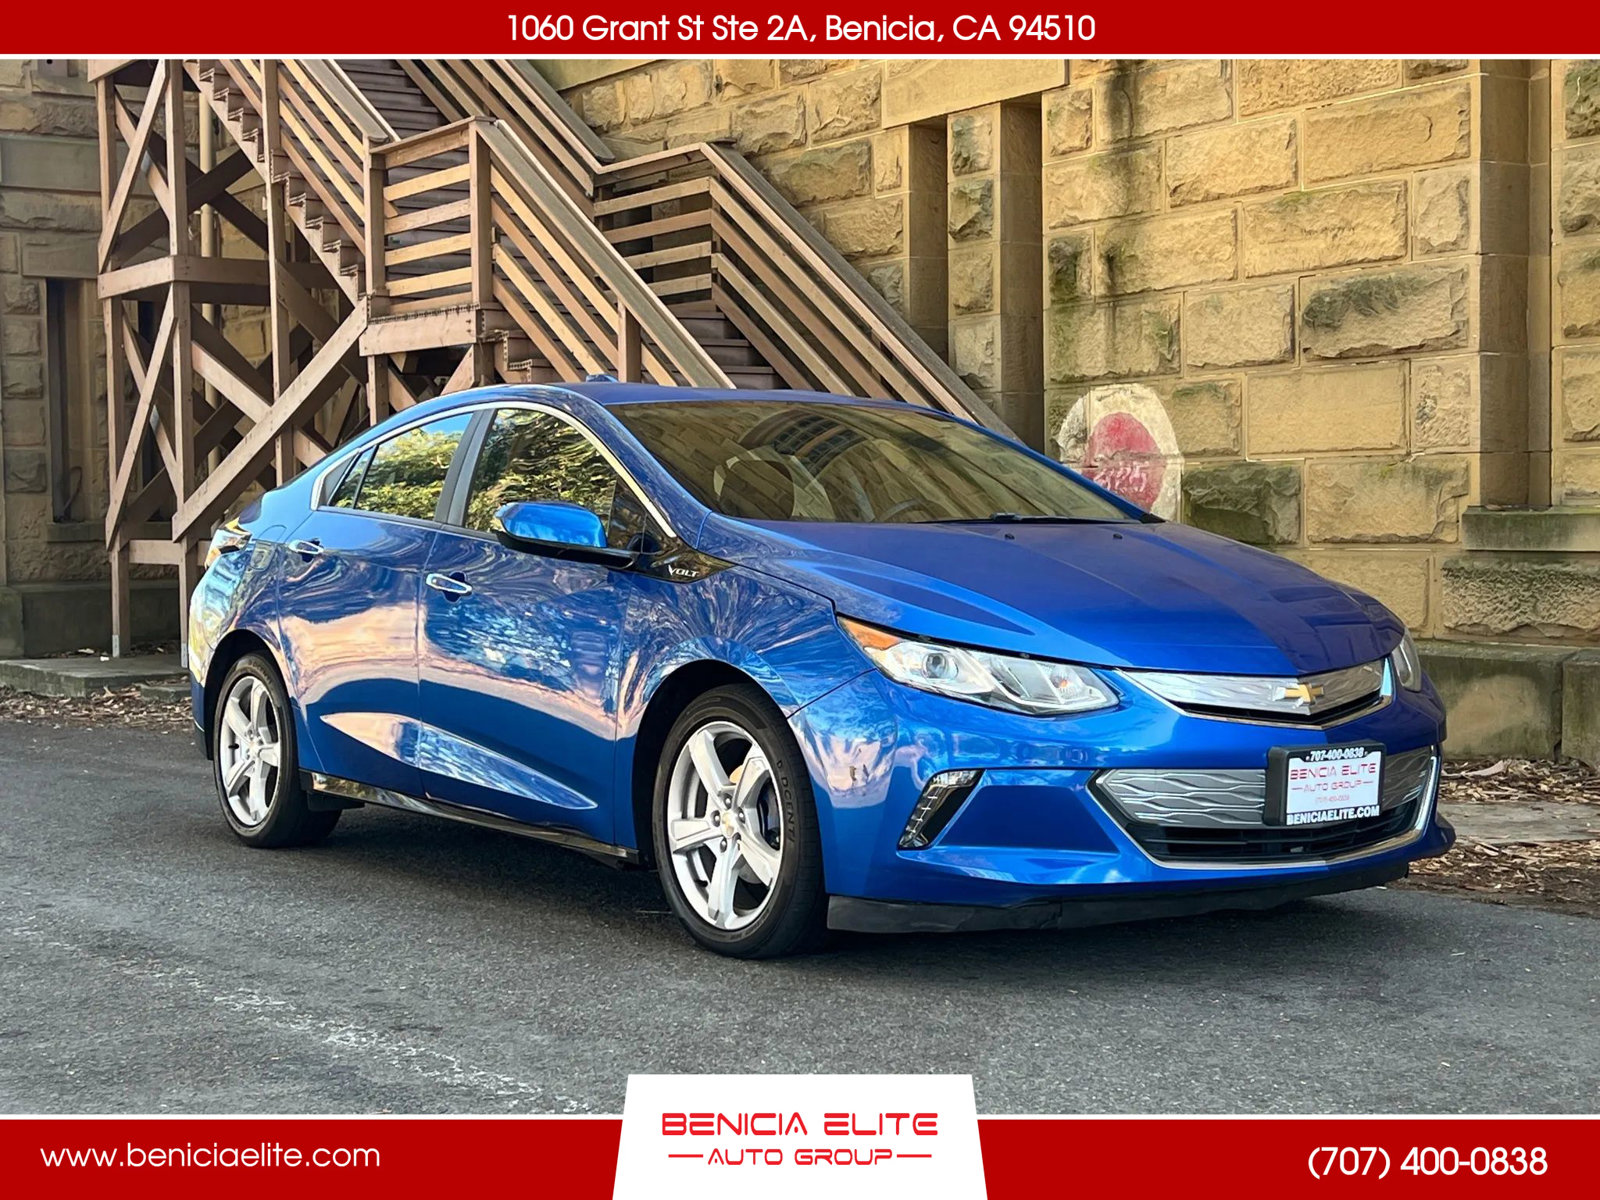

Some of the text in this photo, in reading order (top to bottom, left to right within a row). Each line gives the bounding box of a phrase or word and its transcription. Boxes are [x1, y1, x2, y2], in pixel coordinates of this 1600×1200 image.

[668, 564, 699, 577] VOLT
[1310, 747, 1364, 761] 707-400-0838
[1290, 763, 1376, 780] BENICIA ELITE
[1303, 780, 1362, 793] AUTO GROUP
[1286, 805, 1380, 826] BENICIAELITE.COM
